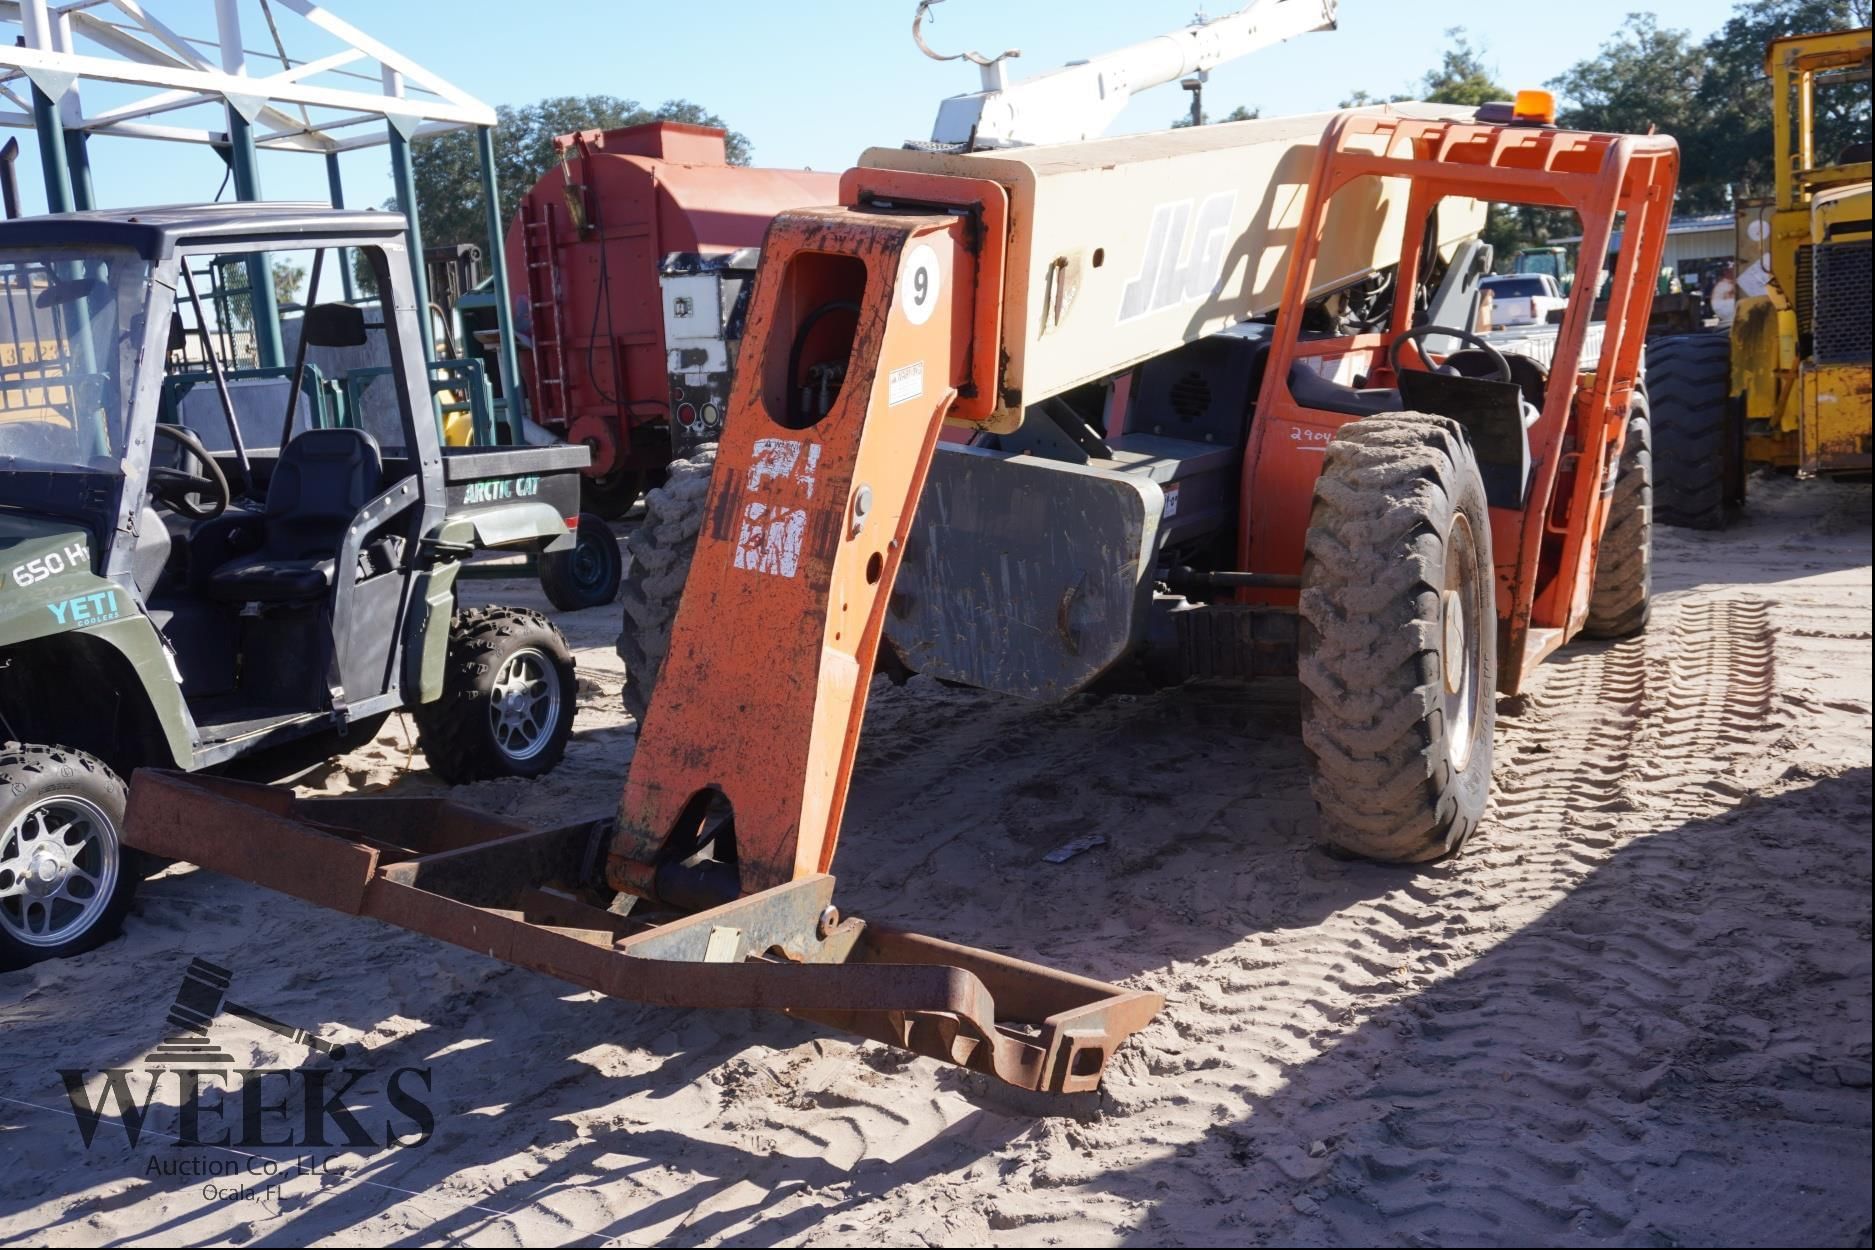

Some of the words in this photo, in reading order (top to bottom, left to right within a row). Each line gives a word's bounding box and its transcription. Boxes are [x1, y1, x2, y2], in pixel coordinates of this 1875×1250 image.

[1115, 191, 1238, 325] JLG
[914, 266, 929, 306] 9
[1290, 427, 1337, 444] 2904
[463, 480, 512, 504] ARCTIC
[515, 476, 541, 497] CAT
[12, 553, 65, 587] 650
[47, 590, 118, 625] YETI
[77, 611, 120, 627] COOLERS
